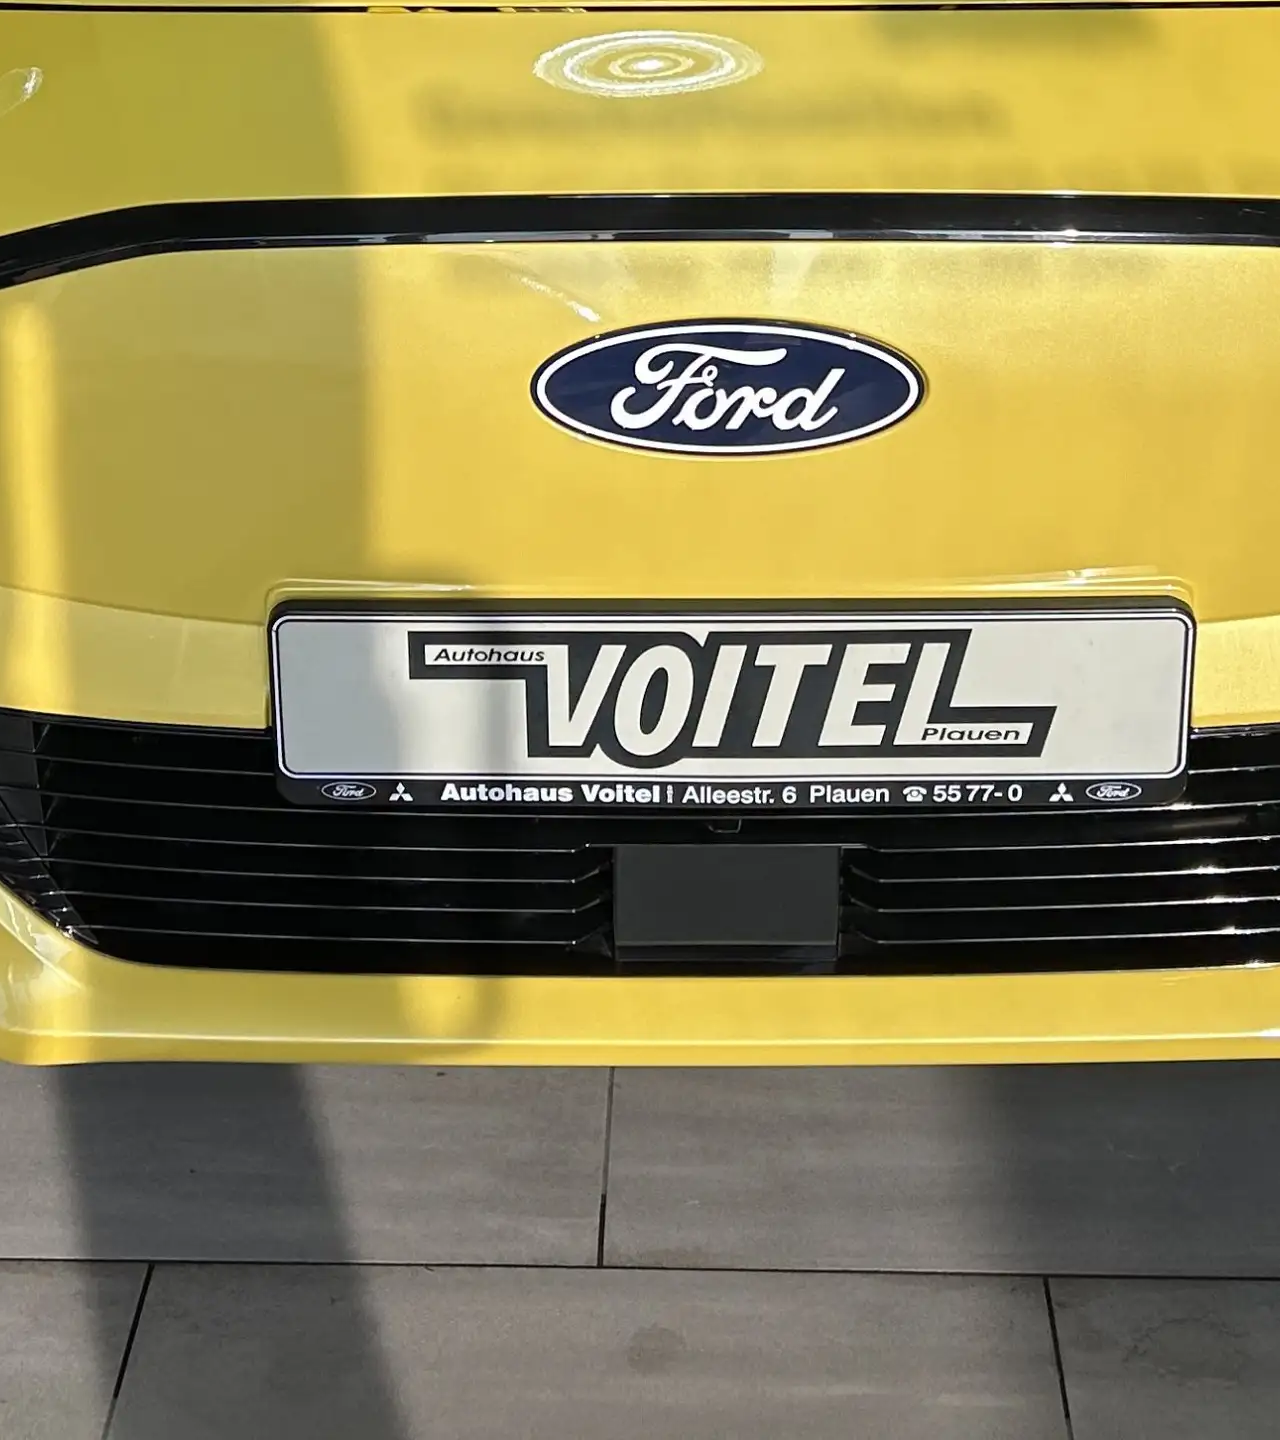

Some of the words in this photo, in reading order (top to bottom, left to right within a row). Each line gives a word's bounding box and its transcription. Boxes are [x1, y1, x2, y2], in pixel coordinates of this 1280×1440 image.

[610, 342, 846, 432] Ford
[433, 647, 546, 663] Autohaus
[546, 642, 952, 757] VOITEL
[920, 726, 1021, 742] Plauen
[440, 782, 574, 803] Autohaus
[580, 783, 661, 804] Voitel
[681, 785, 775, 805] Alleestr.
[781, 785, 797, 805] 6
[809, 784, 890, 804] Plauen
